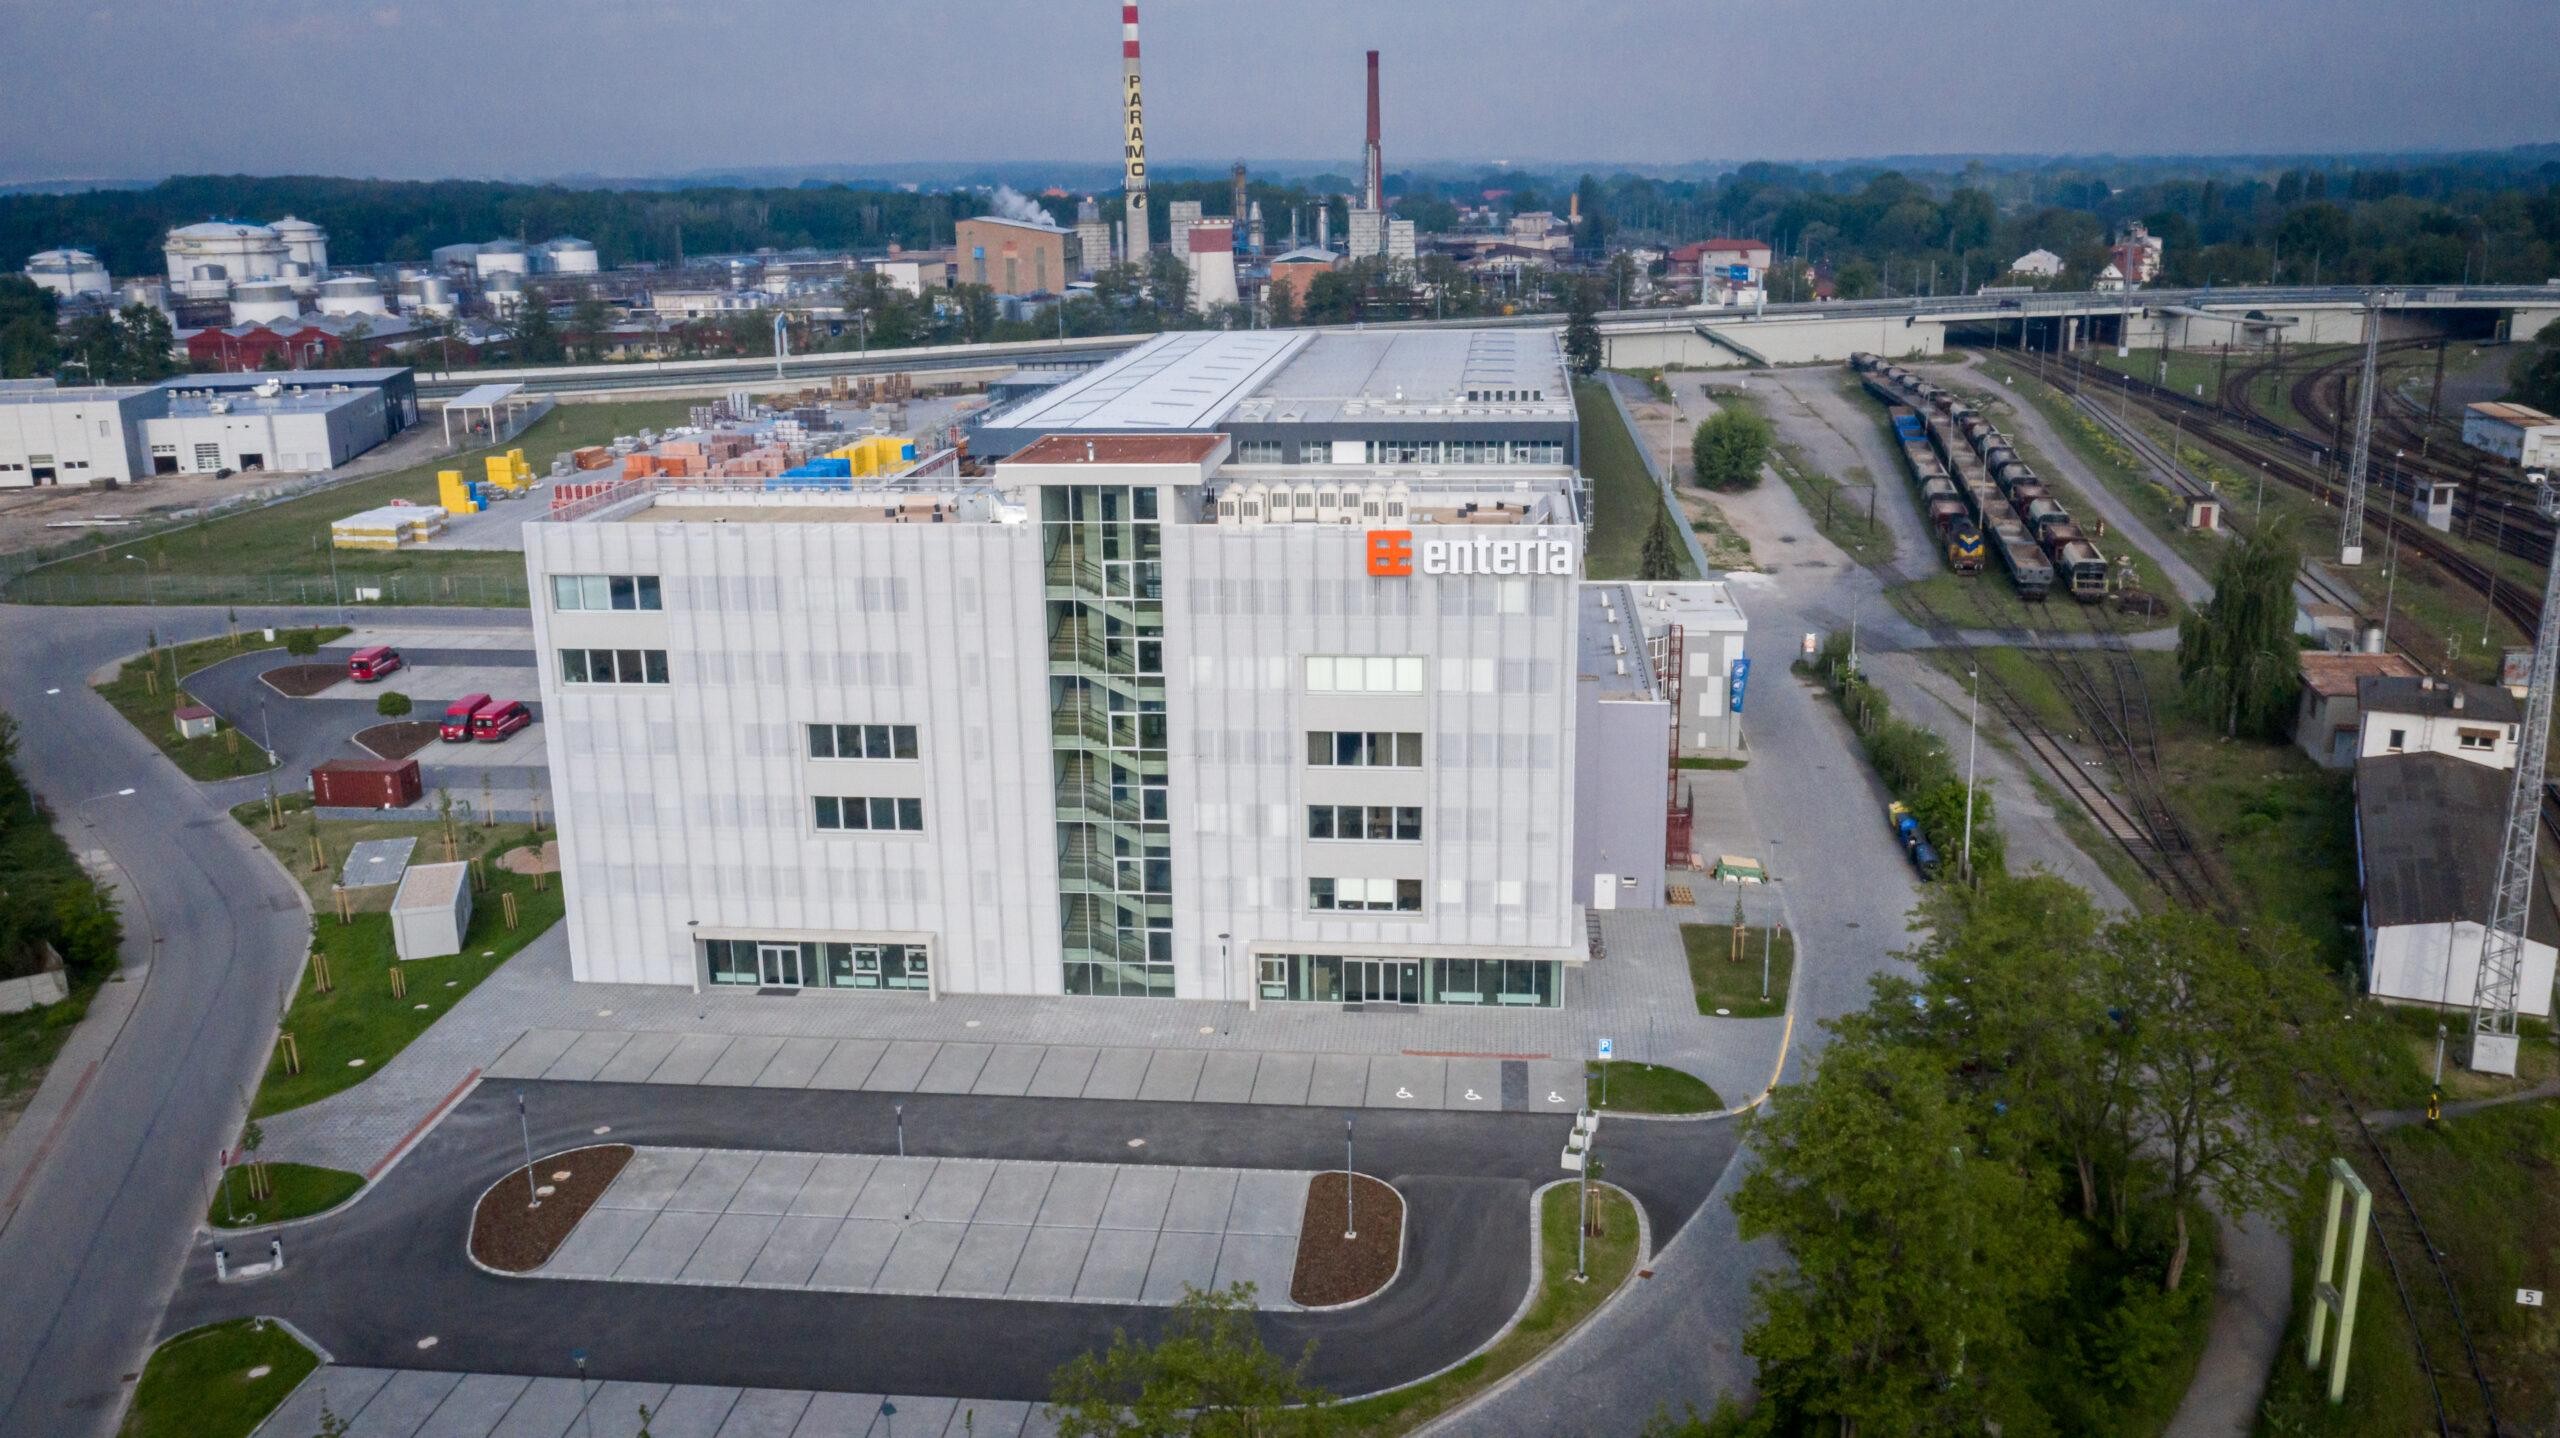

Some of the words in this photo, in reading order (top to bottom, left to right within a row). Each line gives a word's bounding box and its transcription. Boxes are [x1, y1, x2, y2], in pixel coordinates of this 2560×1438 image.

[1129, 75, 1145, 177] PARAMO
[1423, 528, 1573, 575] enteria
[2526, 1291, 2535, 1303] 5
